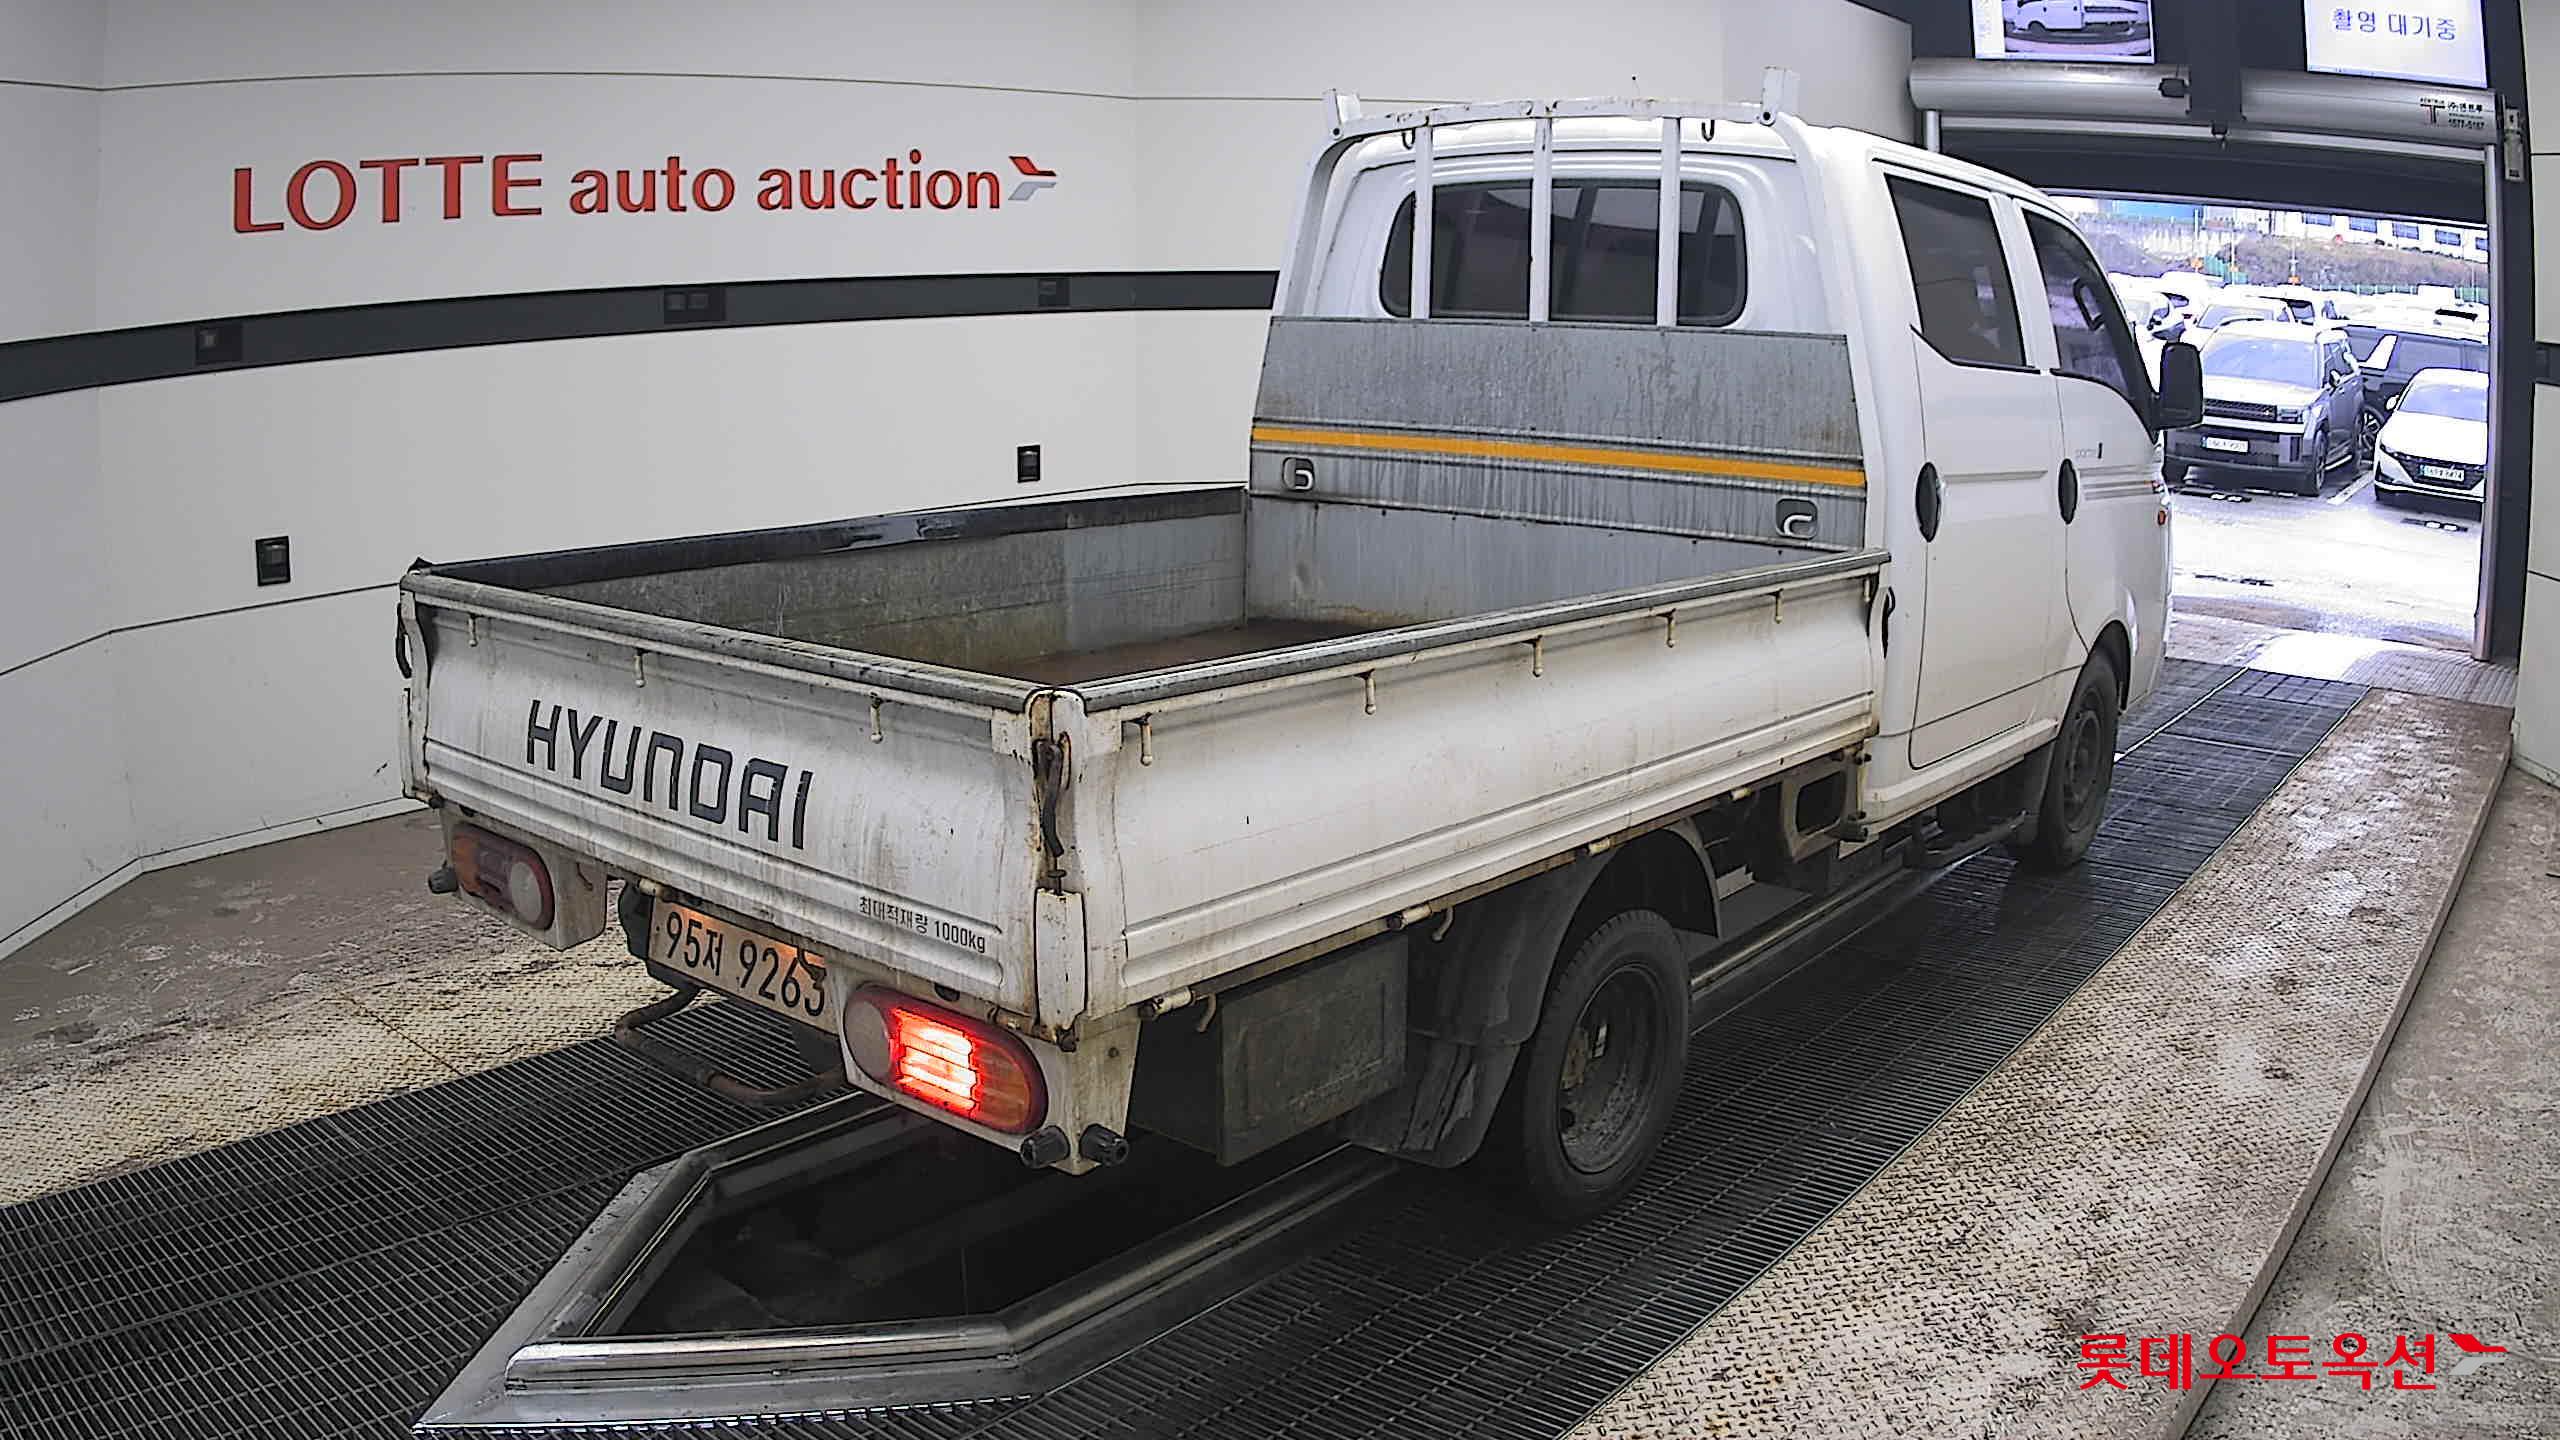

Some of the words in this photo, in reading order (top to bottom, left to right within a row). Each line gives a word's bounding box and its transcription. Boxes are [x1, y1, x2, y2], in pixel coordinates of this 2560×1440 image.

[2333, 8, 2376, 33] 촬영
[2388, 14, 2456, 41] 대기중
[234, 154, 543, 233] LOTTE
[569, 156, 736, 215] auto
[756, 150, 1001, 210] auction
[527, 699, 814, 850] HYUNDAI
[666, 911, 723, 977] 95저
[738, 939, 826, 1016] 9263
[859, 896, 928, 934] 최대적재량
[936, 920, 986, 954] 1000kg
